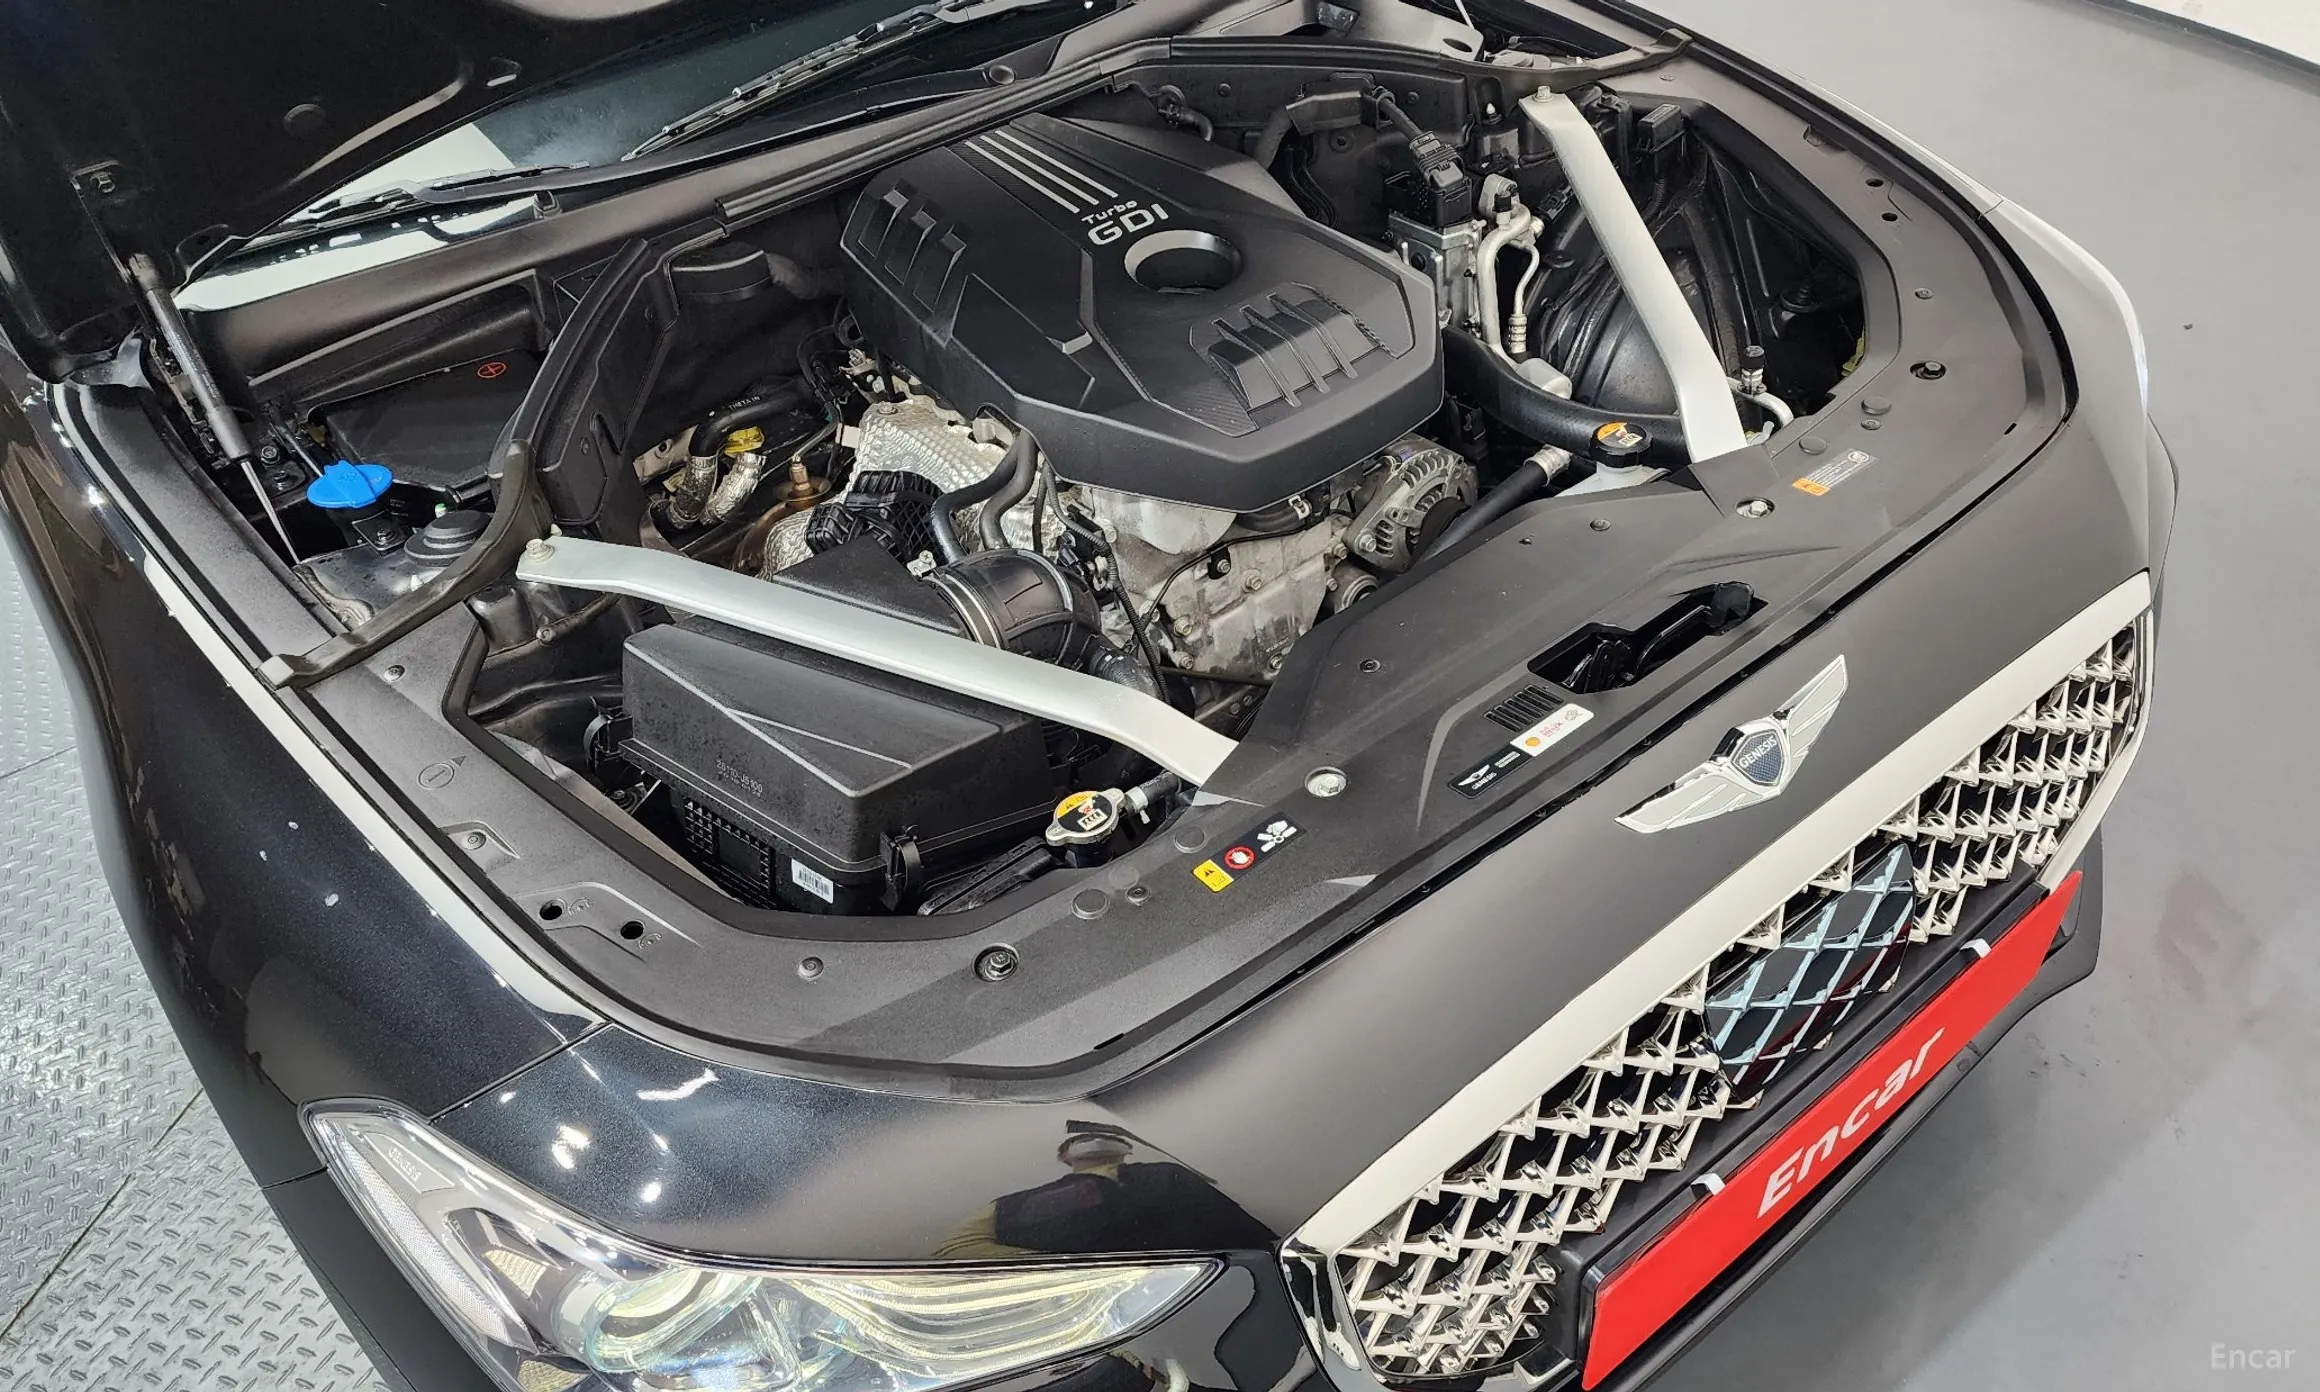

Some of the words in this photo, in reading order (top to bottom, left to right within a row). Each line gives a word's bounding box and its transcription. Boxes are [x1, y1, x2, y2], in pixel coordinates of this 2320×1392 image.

[1081, 200, 1138, 224] Turbo
[1088, 203, 1169, 245] GDI
[728, 399, 751, 410] THETA
[1739, 735, 1777, 769] GENESIS
[1471, 772, 1498, 790] GENESIS
[1756, 1026, 1946, 1219] Encar
[388, 1146, 422, 1182] GENESIS
